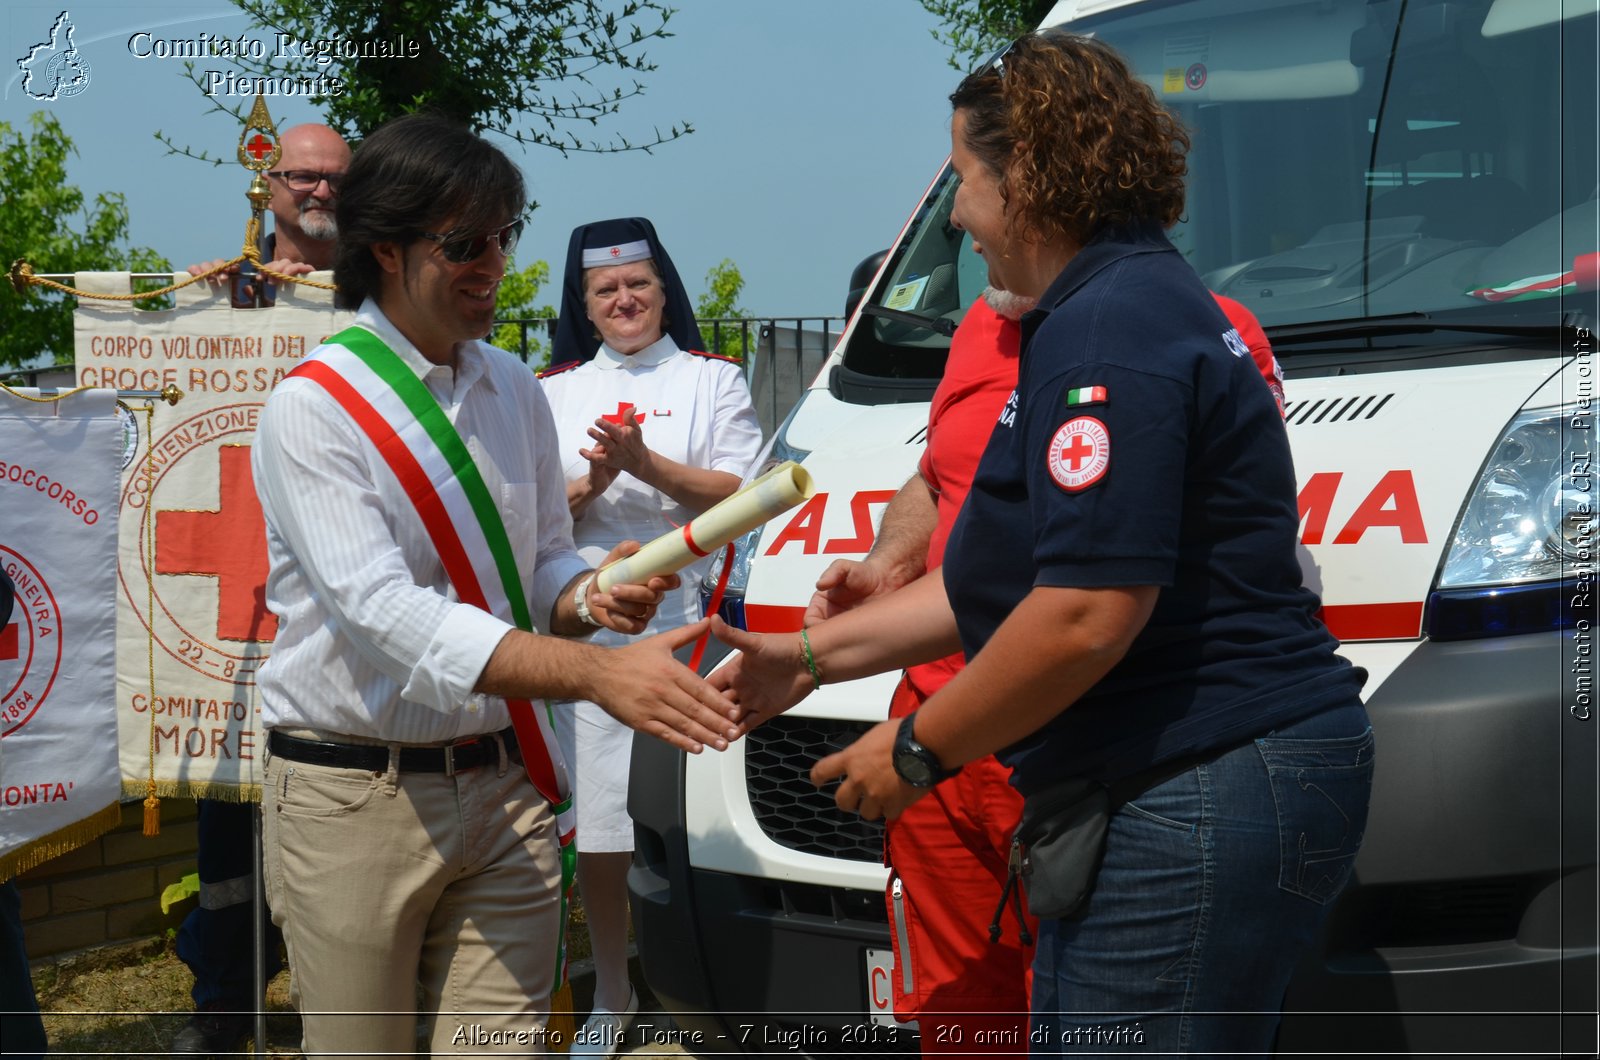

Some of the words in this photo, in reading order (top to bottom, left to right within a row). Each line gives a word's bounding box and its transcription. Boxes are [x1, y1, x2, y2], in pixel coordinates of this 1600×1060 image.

[91, 336, 152, 359] CORPO
[162, 336, 263, 360] VOLONTARI
[80, 367, 178, 390] CROCE
[189, 367, 286, 392] ROSSA
[128, 409, 259, 509] CONVENZIONE
[0, 461, 99, 525] SOCCORSO
[6, 562, 53, 638] GINEVRA
[1, 690, 34, 724] 1864
[132, 693, 247, 722] COMITATO
[153, 725, 256, 760] MORE
[0, 782, 73, 807] ONTA'
